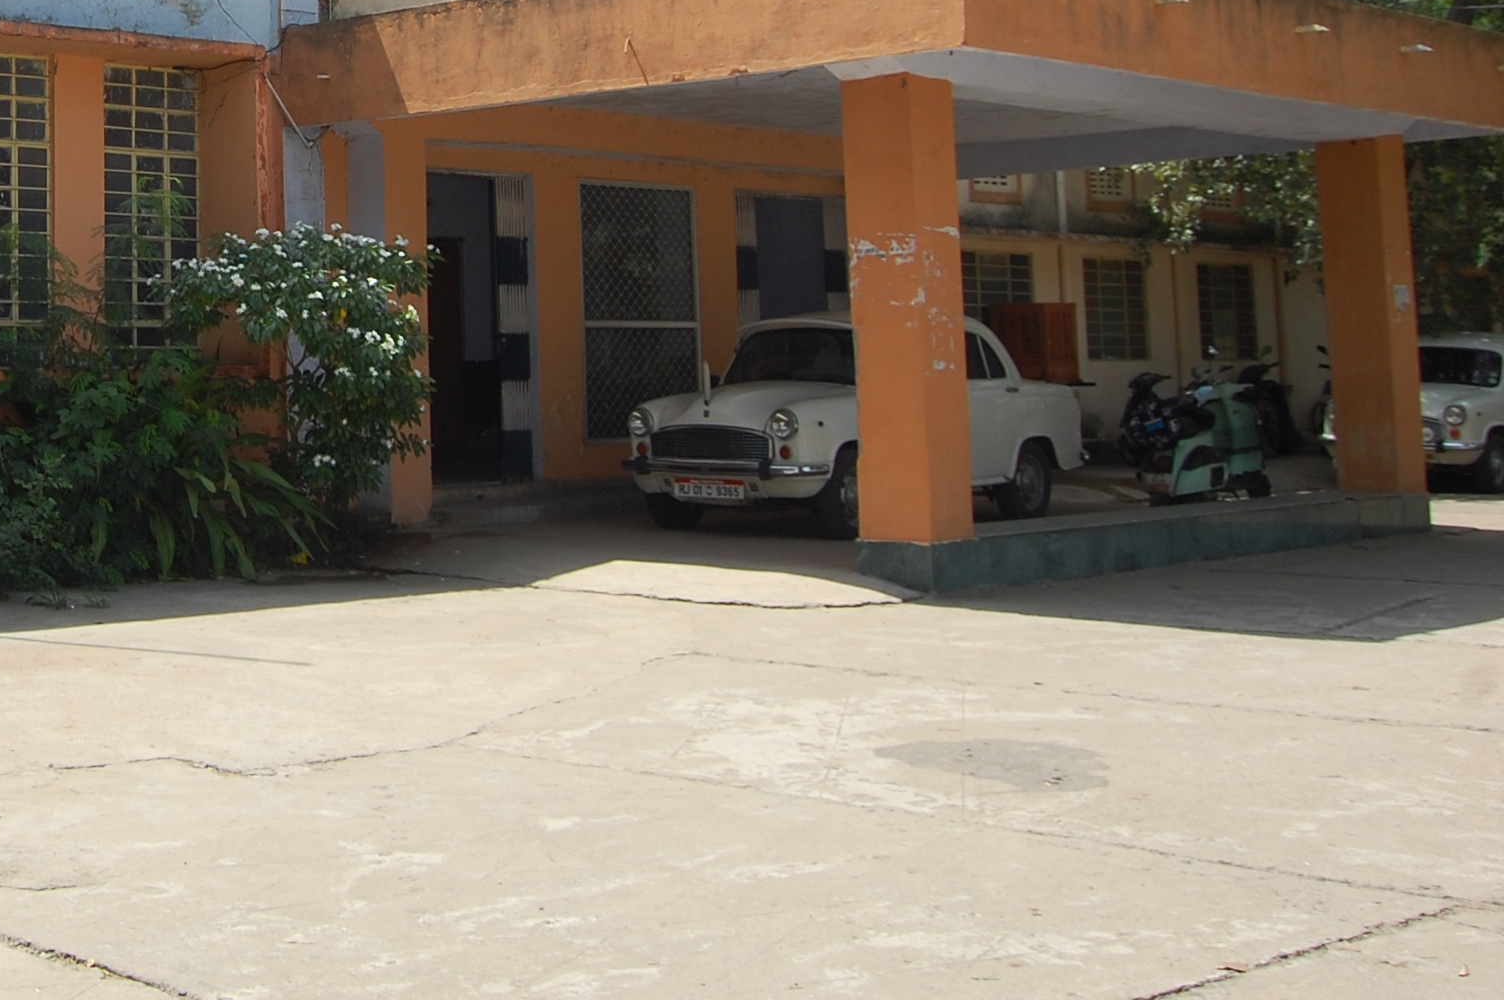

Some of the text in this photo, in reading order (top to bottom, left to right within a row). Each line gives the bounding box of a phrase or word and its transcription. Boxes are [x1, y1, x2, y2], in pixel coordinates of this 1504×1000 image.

[678, 484, 691, 495] RJ
[693, 485, 703, 496] 01
[716, 486, 740, 497] 9365
